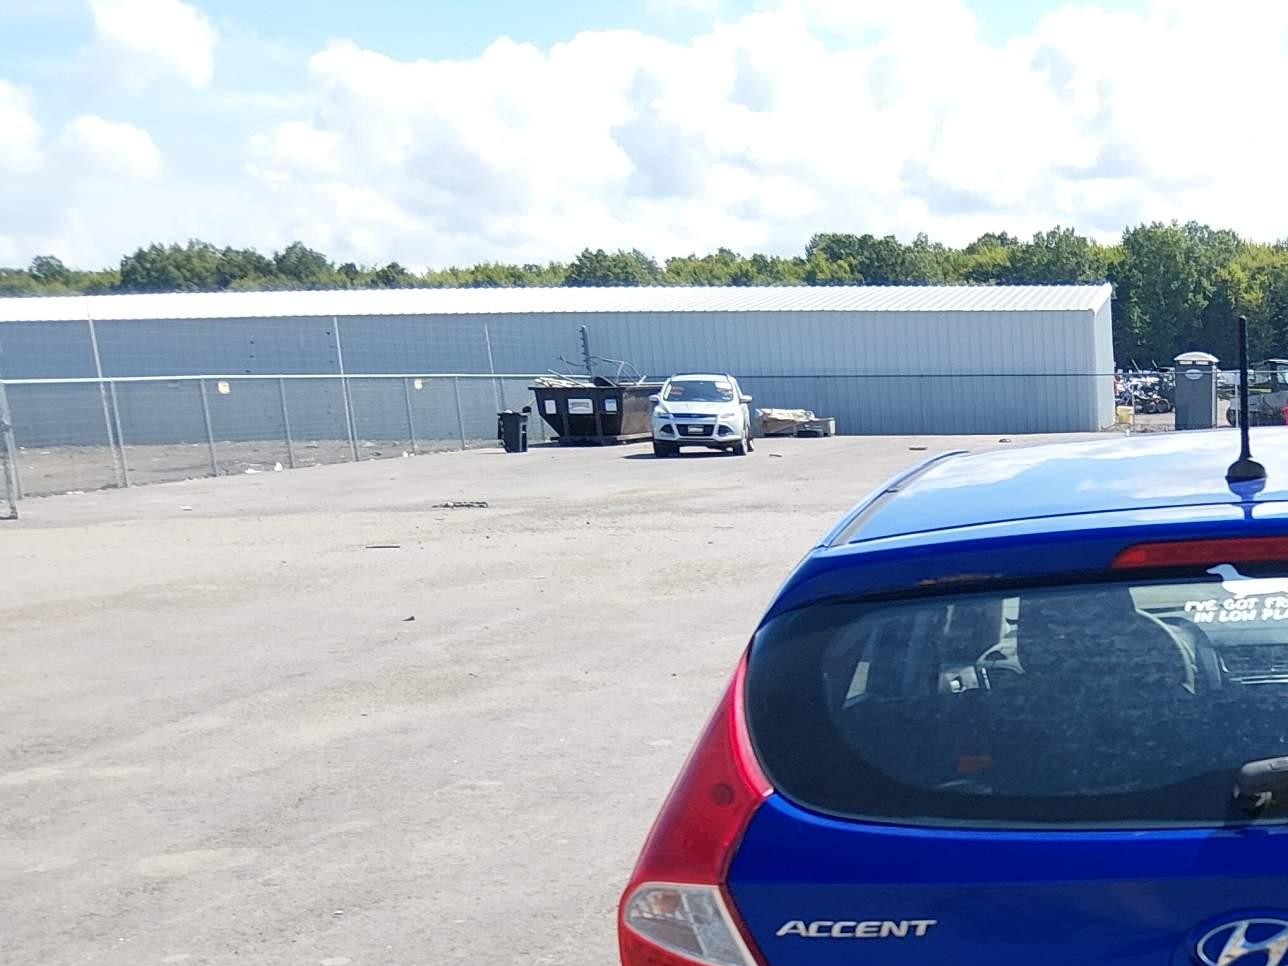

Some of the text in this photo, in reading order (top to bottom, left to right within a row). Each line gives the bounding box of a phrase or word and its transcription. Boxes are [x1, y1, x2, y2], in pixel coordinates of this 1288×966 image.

[1184, 599, 1218, 612] I'VE
[1223, 598, 1259, 610] GOT
[1193, 611, 1215, 623] IN
[1218, 610, 1256, 622] LOW
[776, 920, 938, 937] ACCENT
